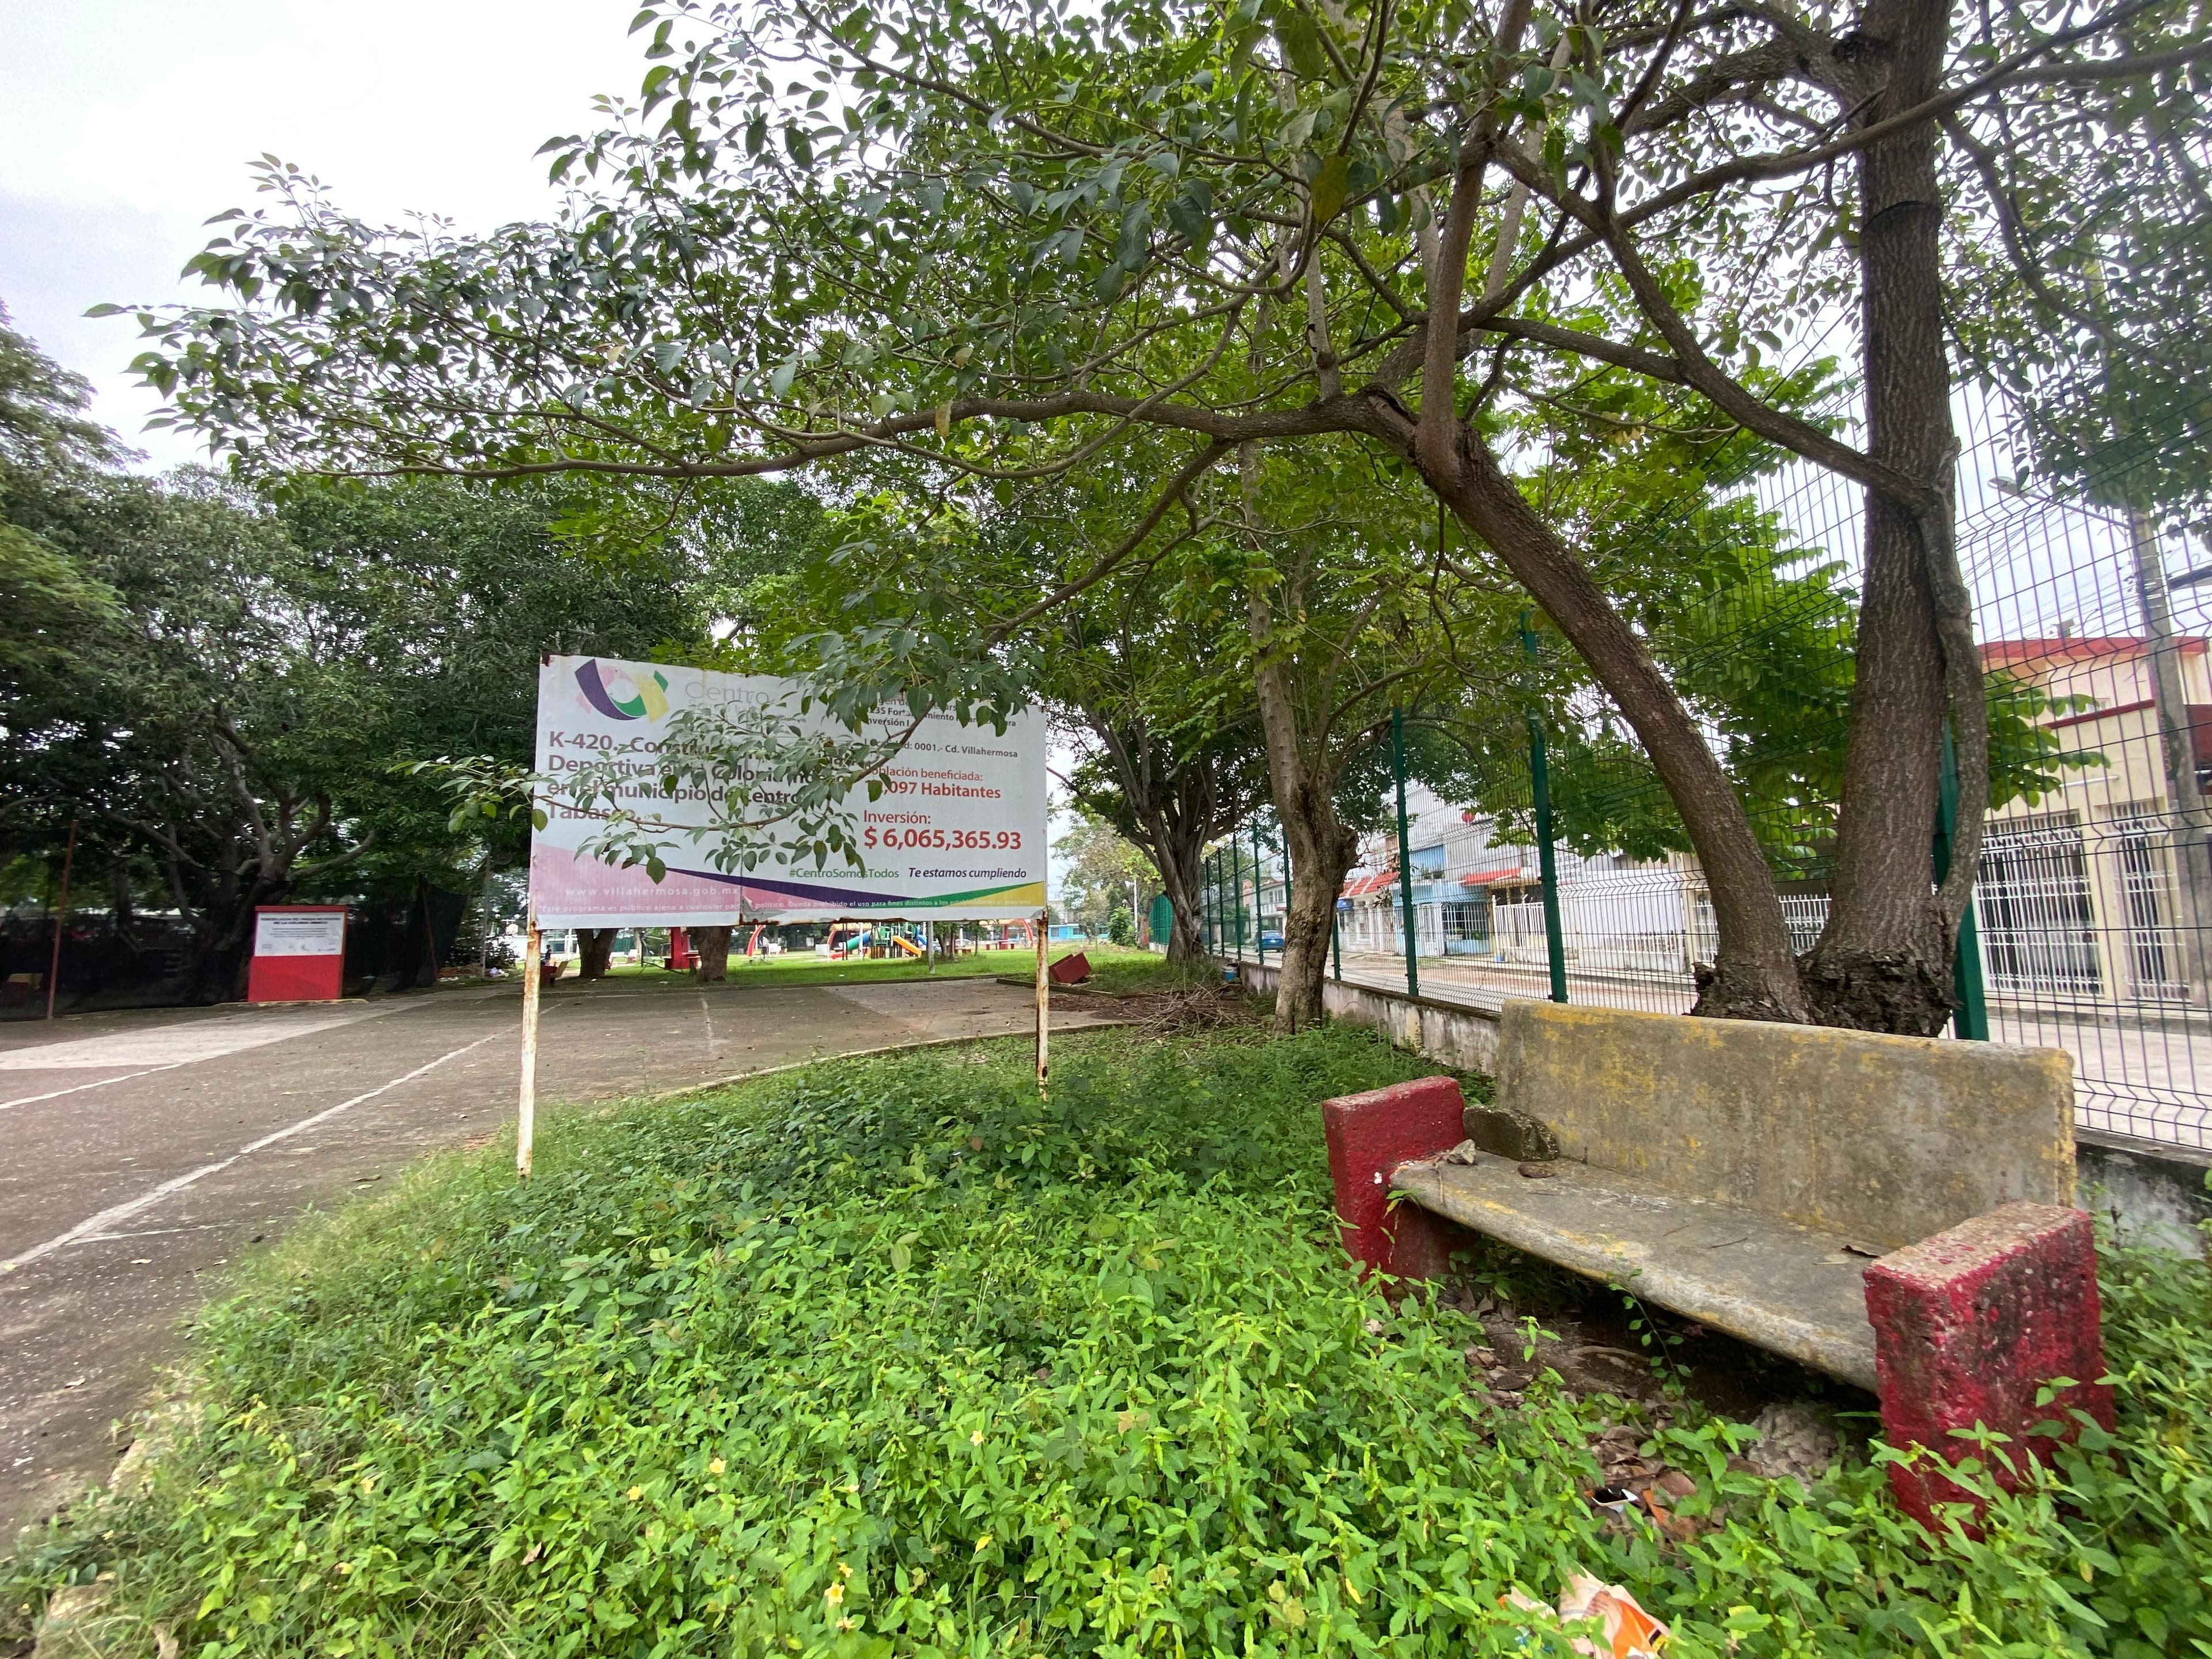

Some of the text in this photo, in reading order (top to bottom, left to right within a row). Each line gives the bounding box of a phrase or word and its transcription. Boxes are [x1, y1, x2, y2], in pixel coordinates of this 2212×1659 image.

[685, 681, 770, 704] Centro
[888, 707, 954, 721] Fortmiento
[865, 717, 905, 726] nversión
[915, 743, 942, 751] 0001.-
[945, 745, 959, 753] Cd.
[961, 746, 1018, 757] Villahermosa
[548, 755, 655, 776] Deportiva
[922, 767, 983, 781] beneficiada:
[607, 782, 706, 804] muicpio
[739, 787, 805, 804] entro
[865, 779, 1001, 798] ,097 Habitantes
[546, 802, 641, 821] Tabaso.
[864, 810, 931, 824] Inversión:
[883, 828, 1021, 851] 6,065,365.93
[789, 868, 1027, 880] #CentroSomosTodos Te estamos cumpliendo
[565, 886, 739, 897] www.villahermosa.gob.mx
